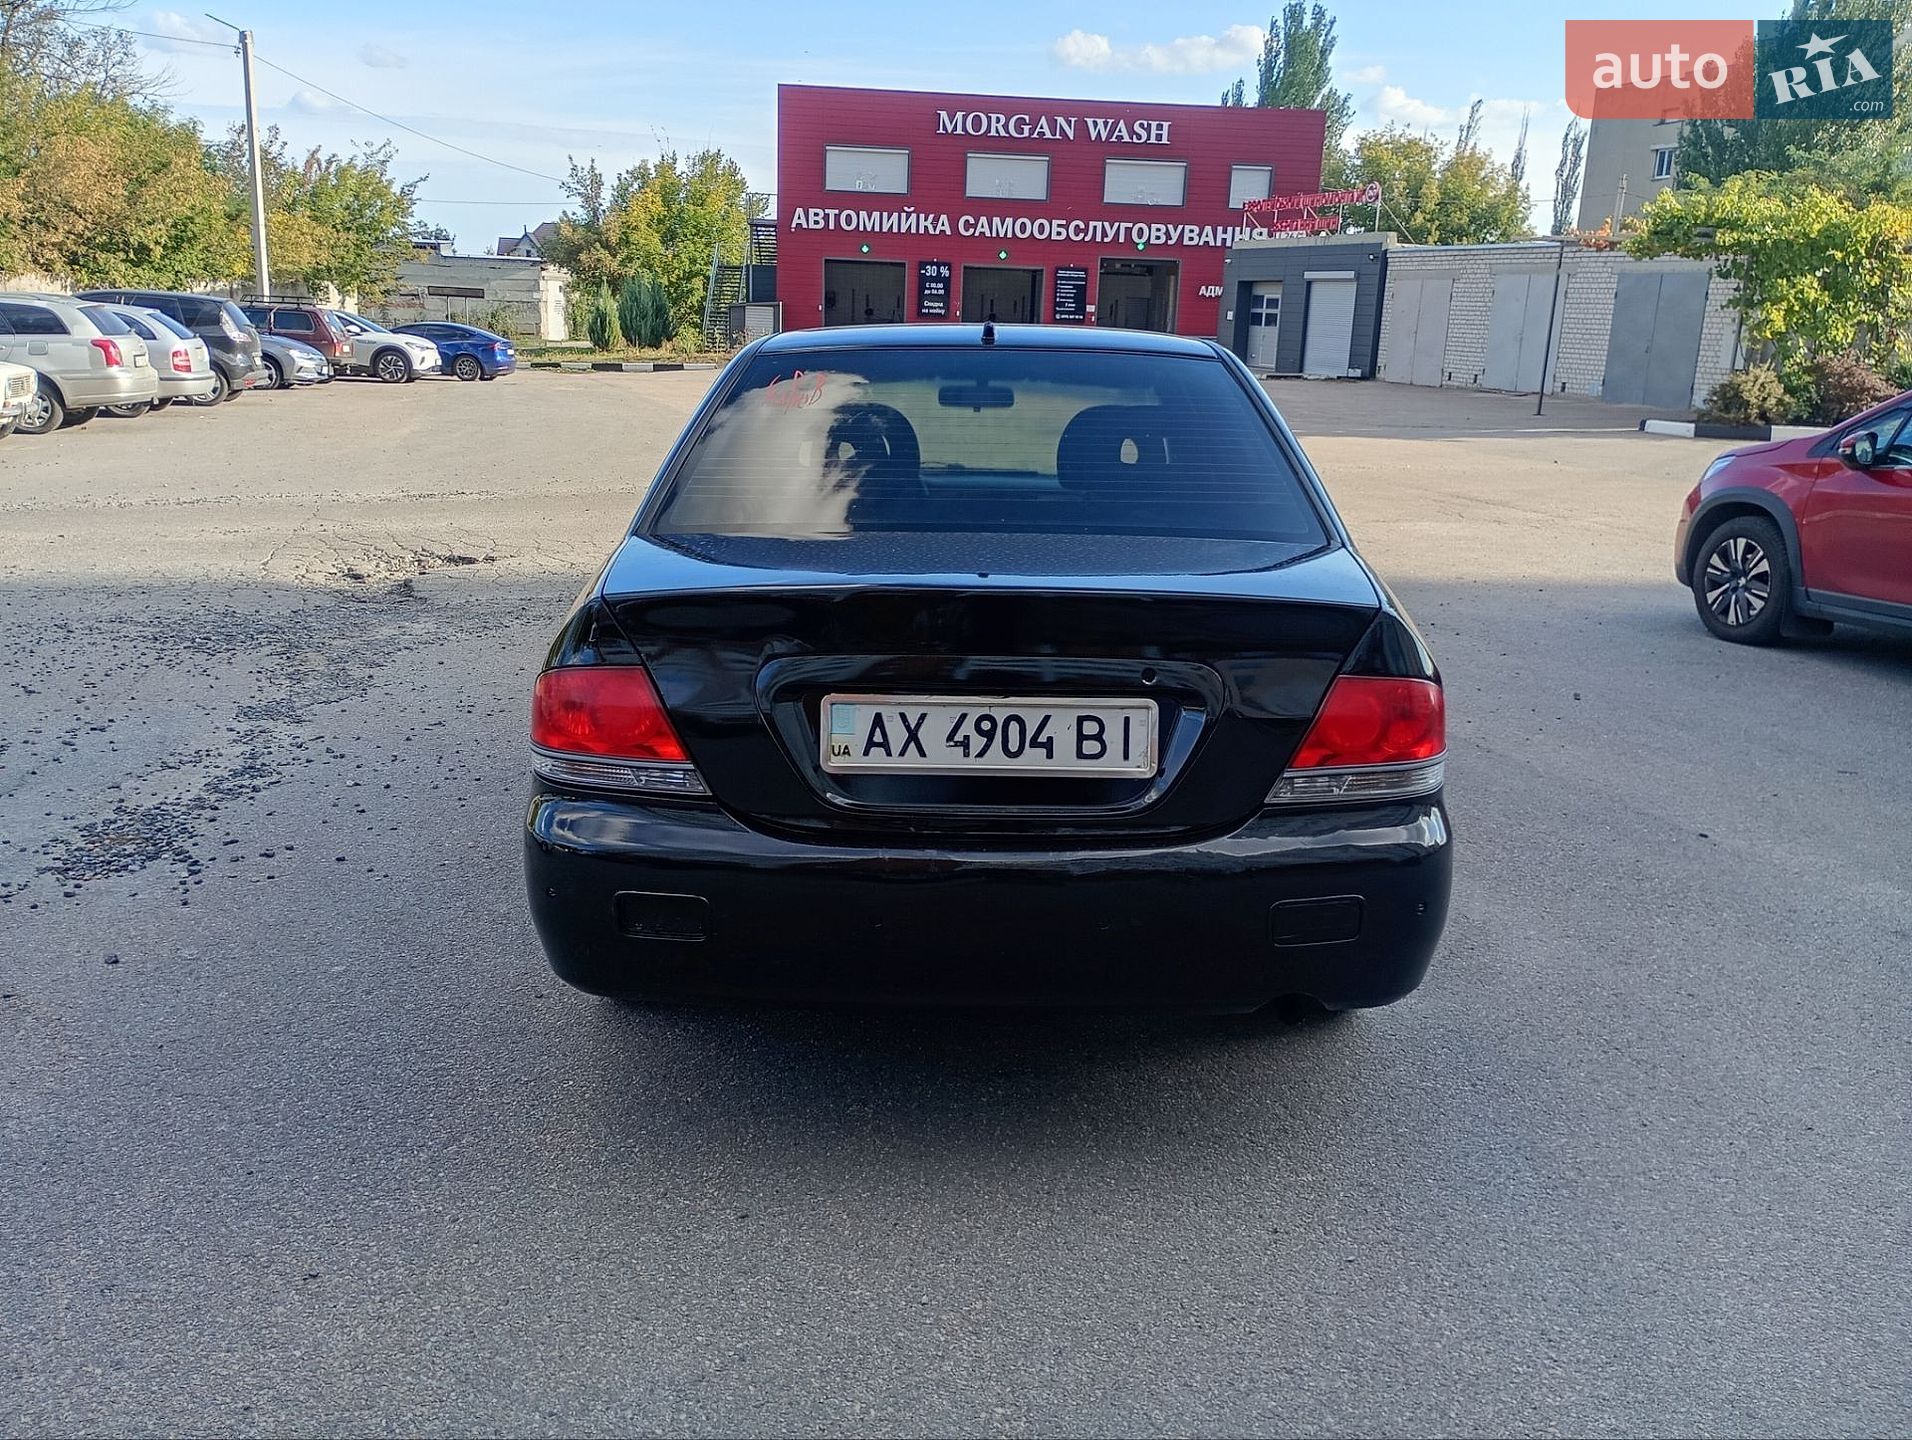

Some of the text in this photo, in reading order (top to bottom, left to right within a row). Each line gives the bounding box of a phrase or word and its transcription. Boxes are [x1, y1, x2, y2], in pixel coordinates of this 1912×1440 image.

[936, 110, 1172, 145] MORGAN WASH
[791, 206, 952, 236] АВТОМИЙКА
[958, 215, 1268, 246] САМООБСЛУГОВУВАННЯ
[920, 266, 950, 277] -30 %
[831, 744, 851, 757] UA
[862, 711, 1131, 761] AX 4904 BI
